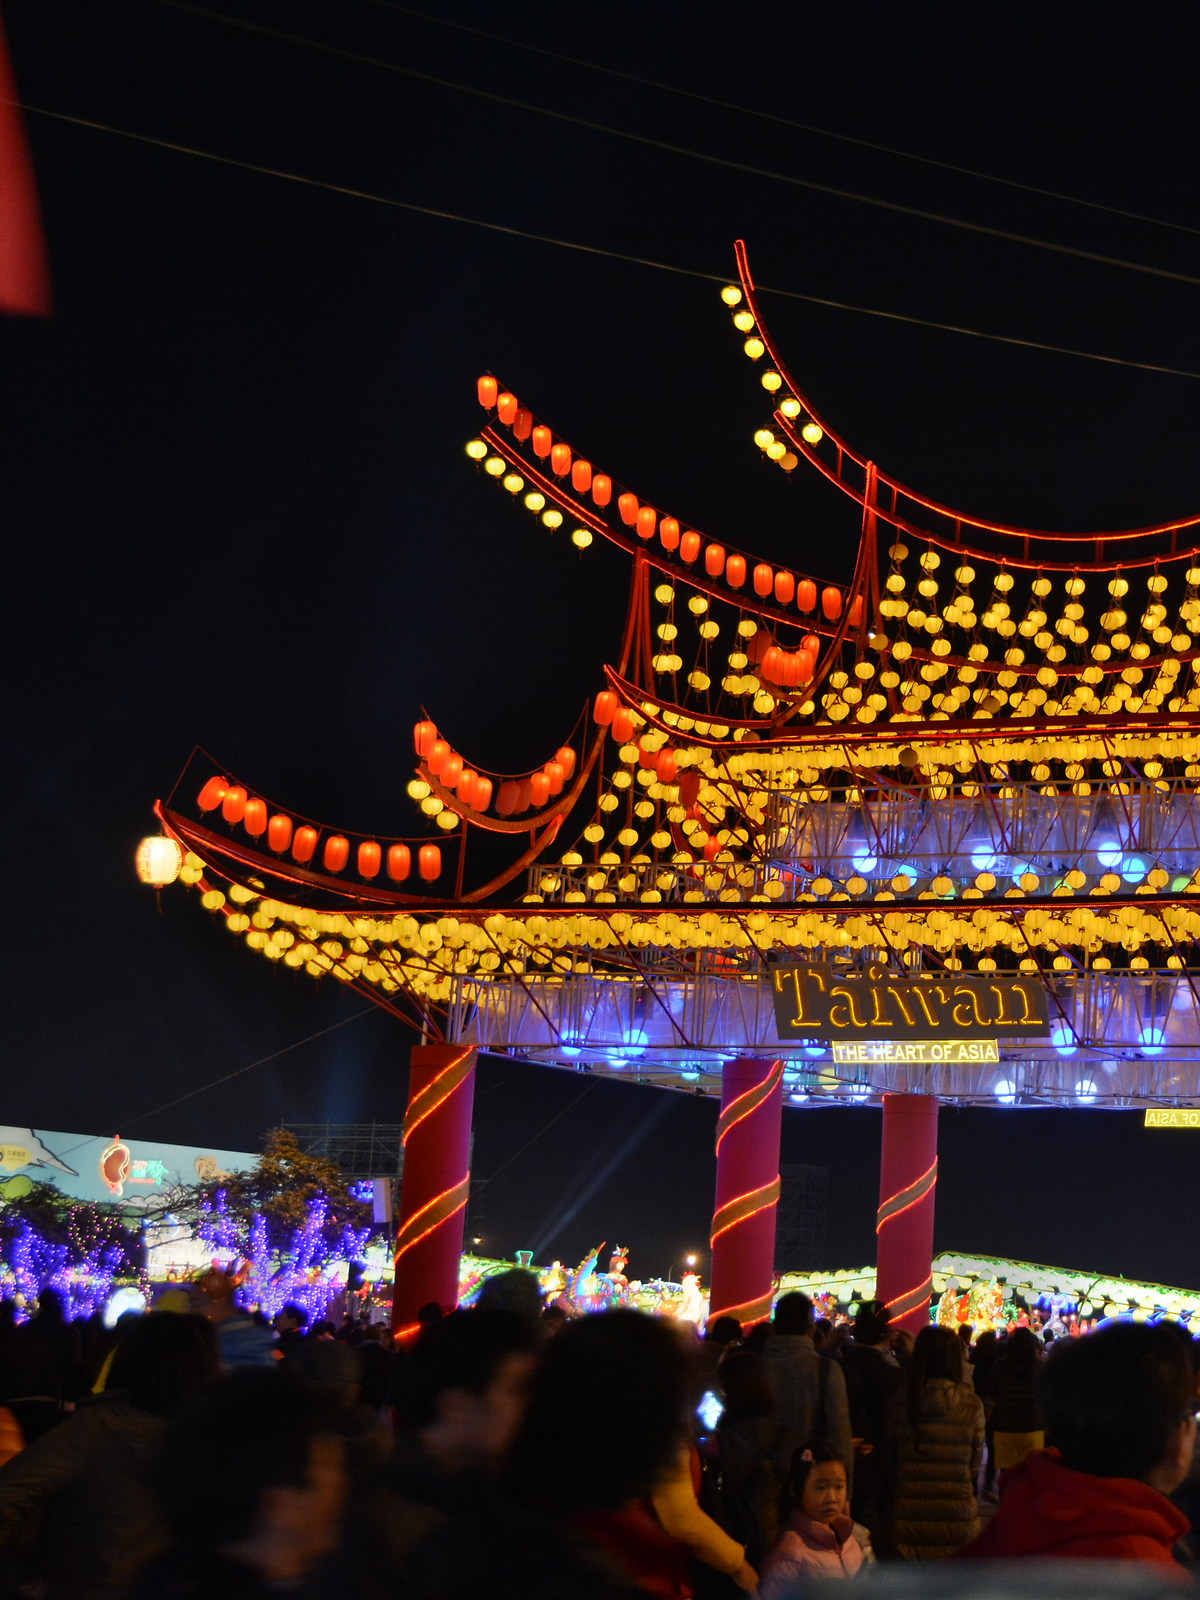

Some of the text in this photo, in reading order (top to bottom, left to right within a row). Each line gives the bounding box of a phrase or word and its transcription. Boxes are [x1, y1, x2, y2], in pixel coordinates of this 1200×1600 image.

[775, 966, 1043, 1028] Taiwan
[835, 1044, 998, 1061] THE HEART OF ASIA
